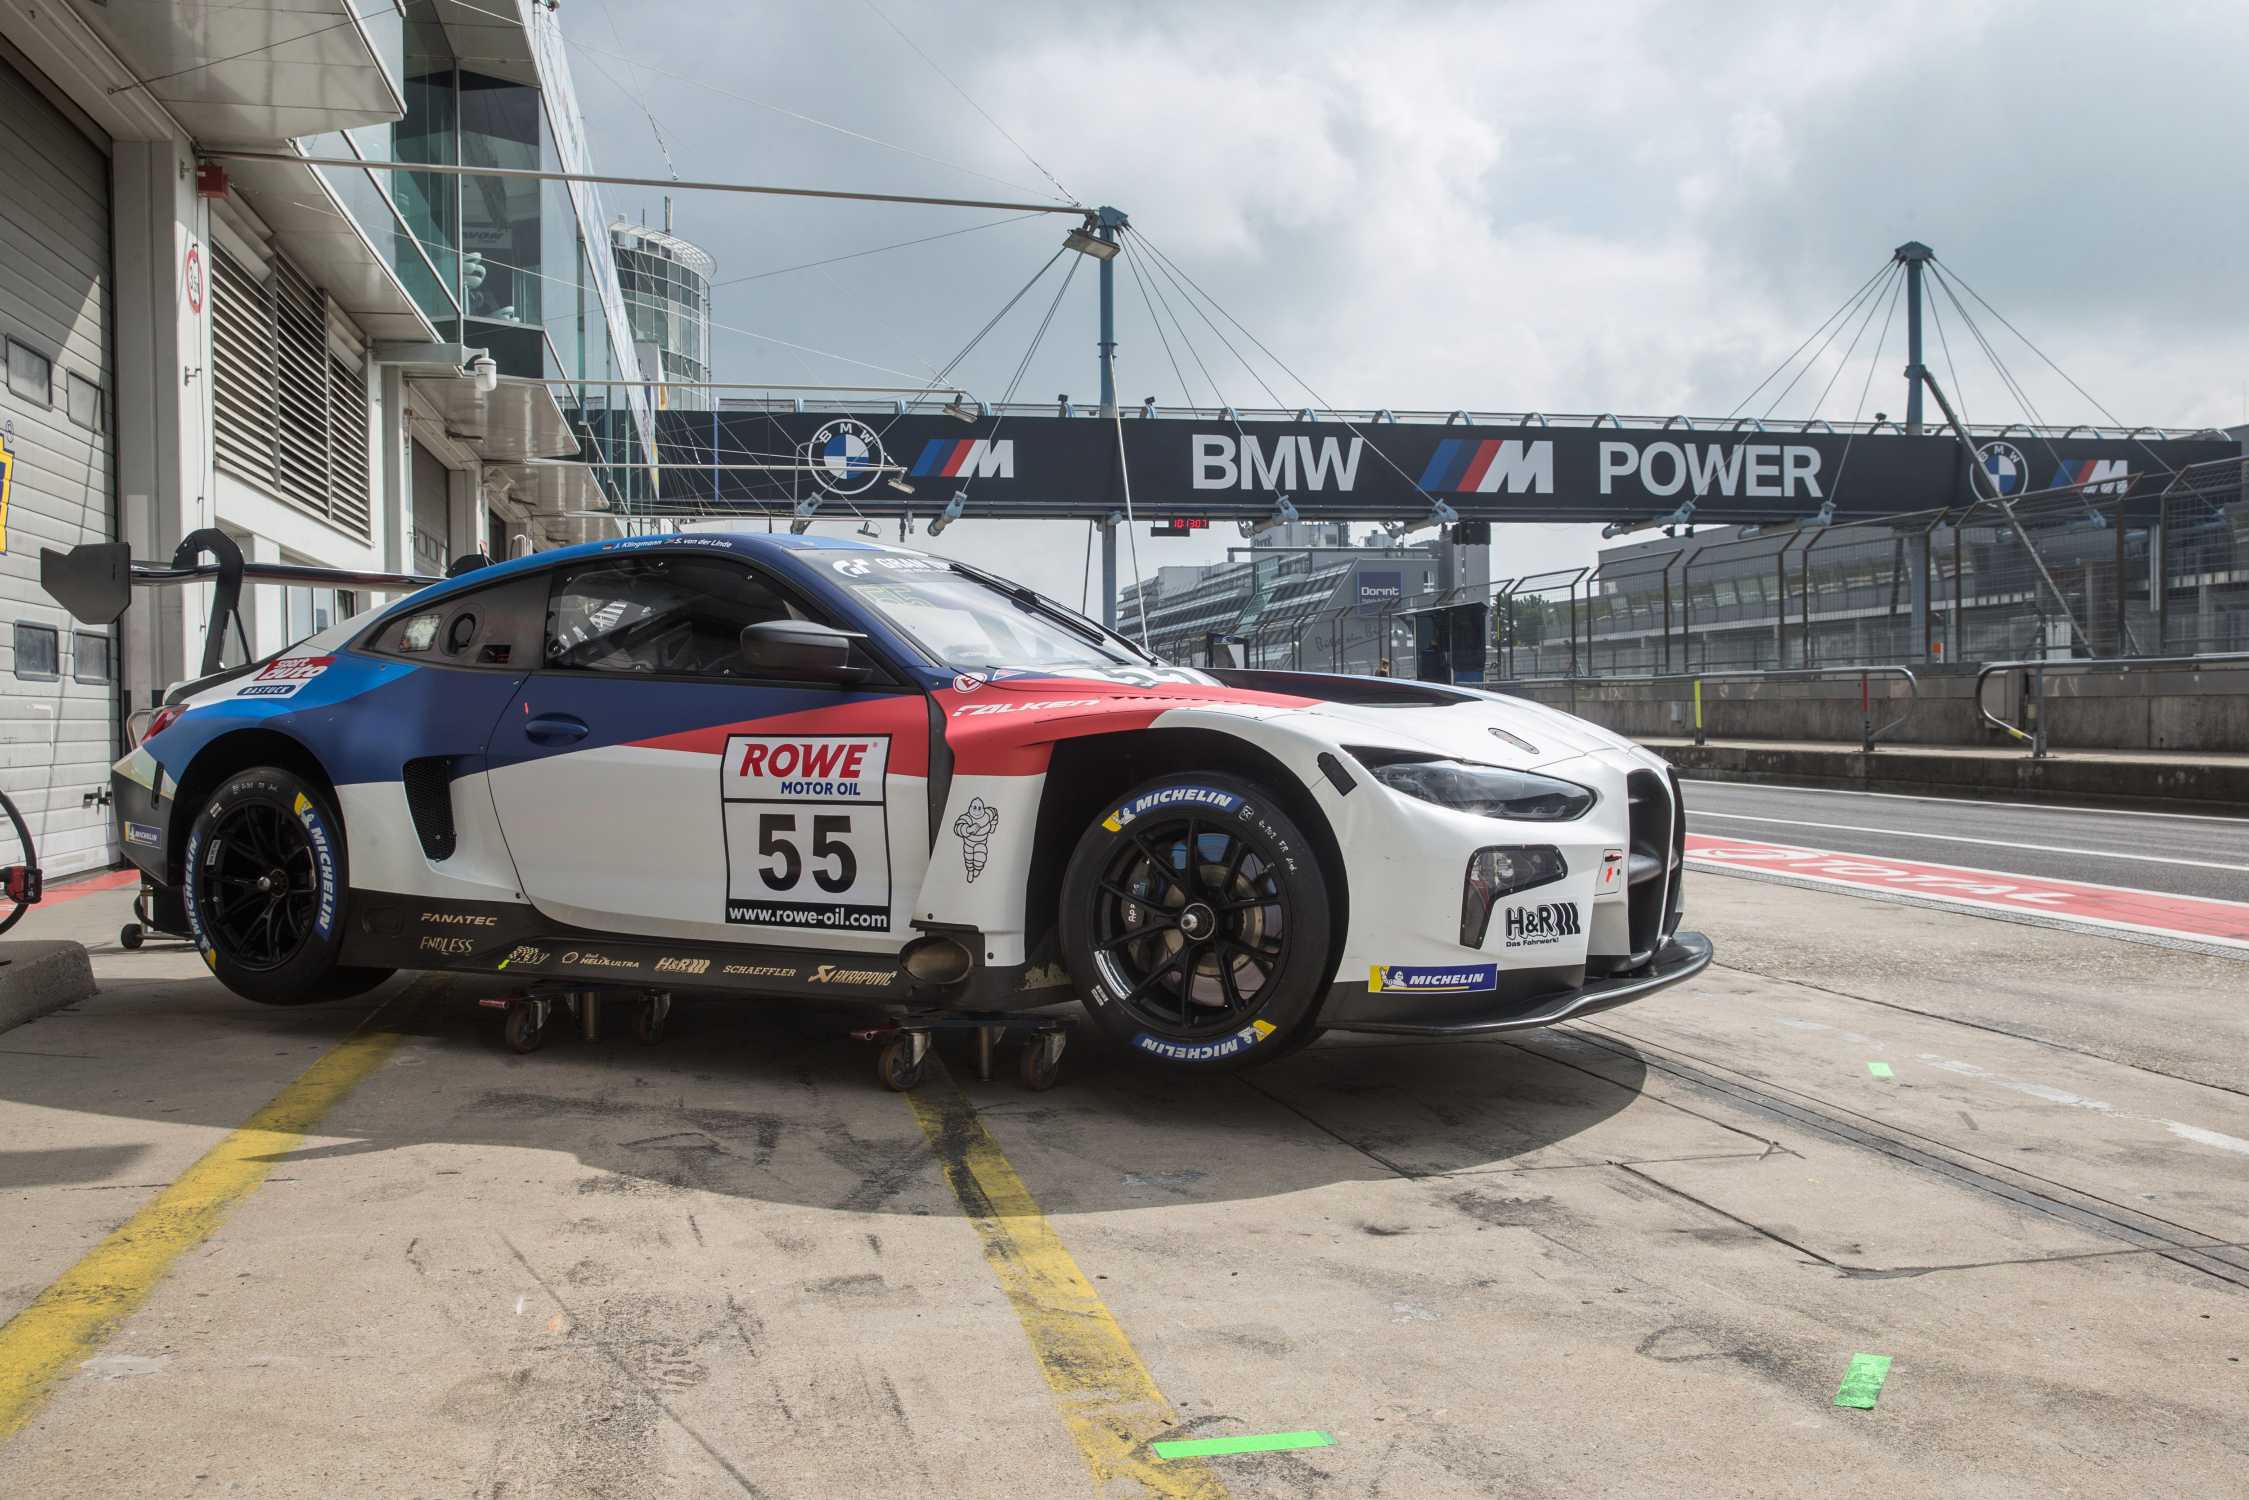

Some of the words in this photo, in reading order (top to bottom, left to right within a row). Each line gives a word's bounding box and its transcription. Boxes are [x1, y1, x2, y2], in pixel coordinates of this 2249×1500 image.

[819, 423, 874, 443] BMW
[1976, 445, 2021, 464] BMW
[1191, 433, 1364, 492] BMW
[1599, 441, 1825, 498] POWER
[622, 540, 663, 550] Klingmann
[711, 539, 733, 548] Linde
[1361, 586, 1400, 596] Dorint
[278, 657, 311, 668] sport
[257, 664, 329, 680] auto
[243, 686, 290, 695] BASTUCK
[952, 699, 1100, 717] FALKEN
[739, 743, 869, 779] ROWE
[780, 781, 833, 796] MOTOR
[837, 781, 861, 796] OIL
[1136, 788, 1233, 813] MICHELIN
[758, 813, 857, 894] 55
[184, 837, 200, 936] MICHELIN
[311, 826, 334, 930] MICHELIN
[420, 912, 497, 927] FANATEC
[729, 905, 888, 928] www.rowe-oil.com
[1506, 904, 1558, 939] H&R
[420, 935, 476, 955] ENDLESS
[1522, 937, 1559, 946] Fahrwerk!
[580, 957, 609, 967] HELIX
[610, 960, 640, 968] ULTRA
[655, 956, 691, 974] H&R
[722, 964, 797, 977] SCHAEFFLER
[1409, 972, 1485, 985] MICHELIN
[1142, 1037, 1239, 1060] MICHELIN
